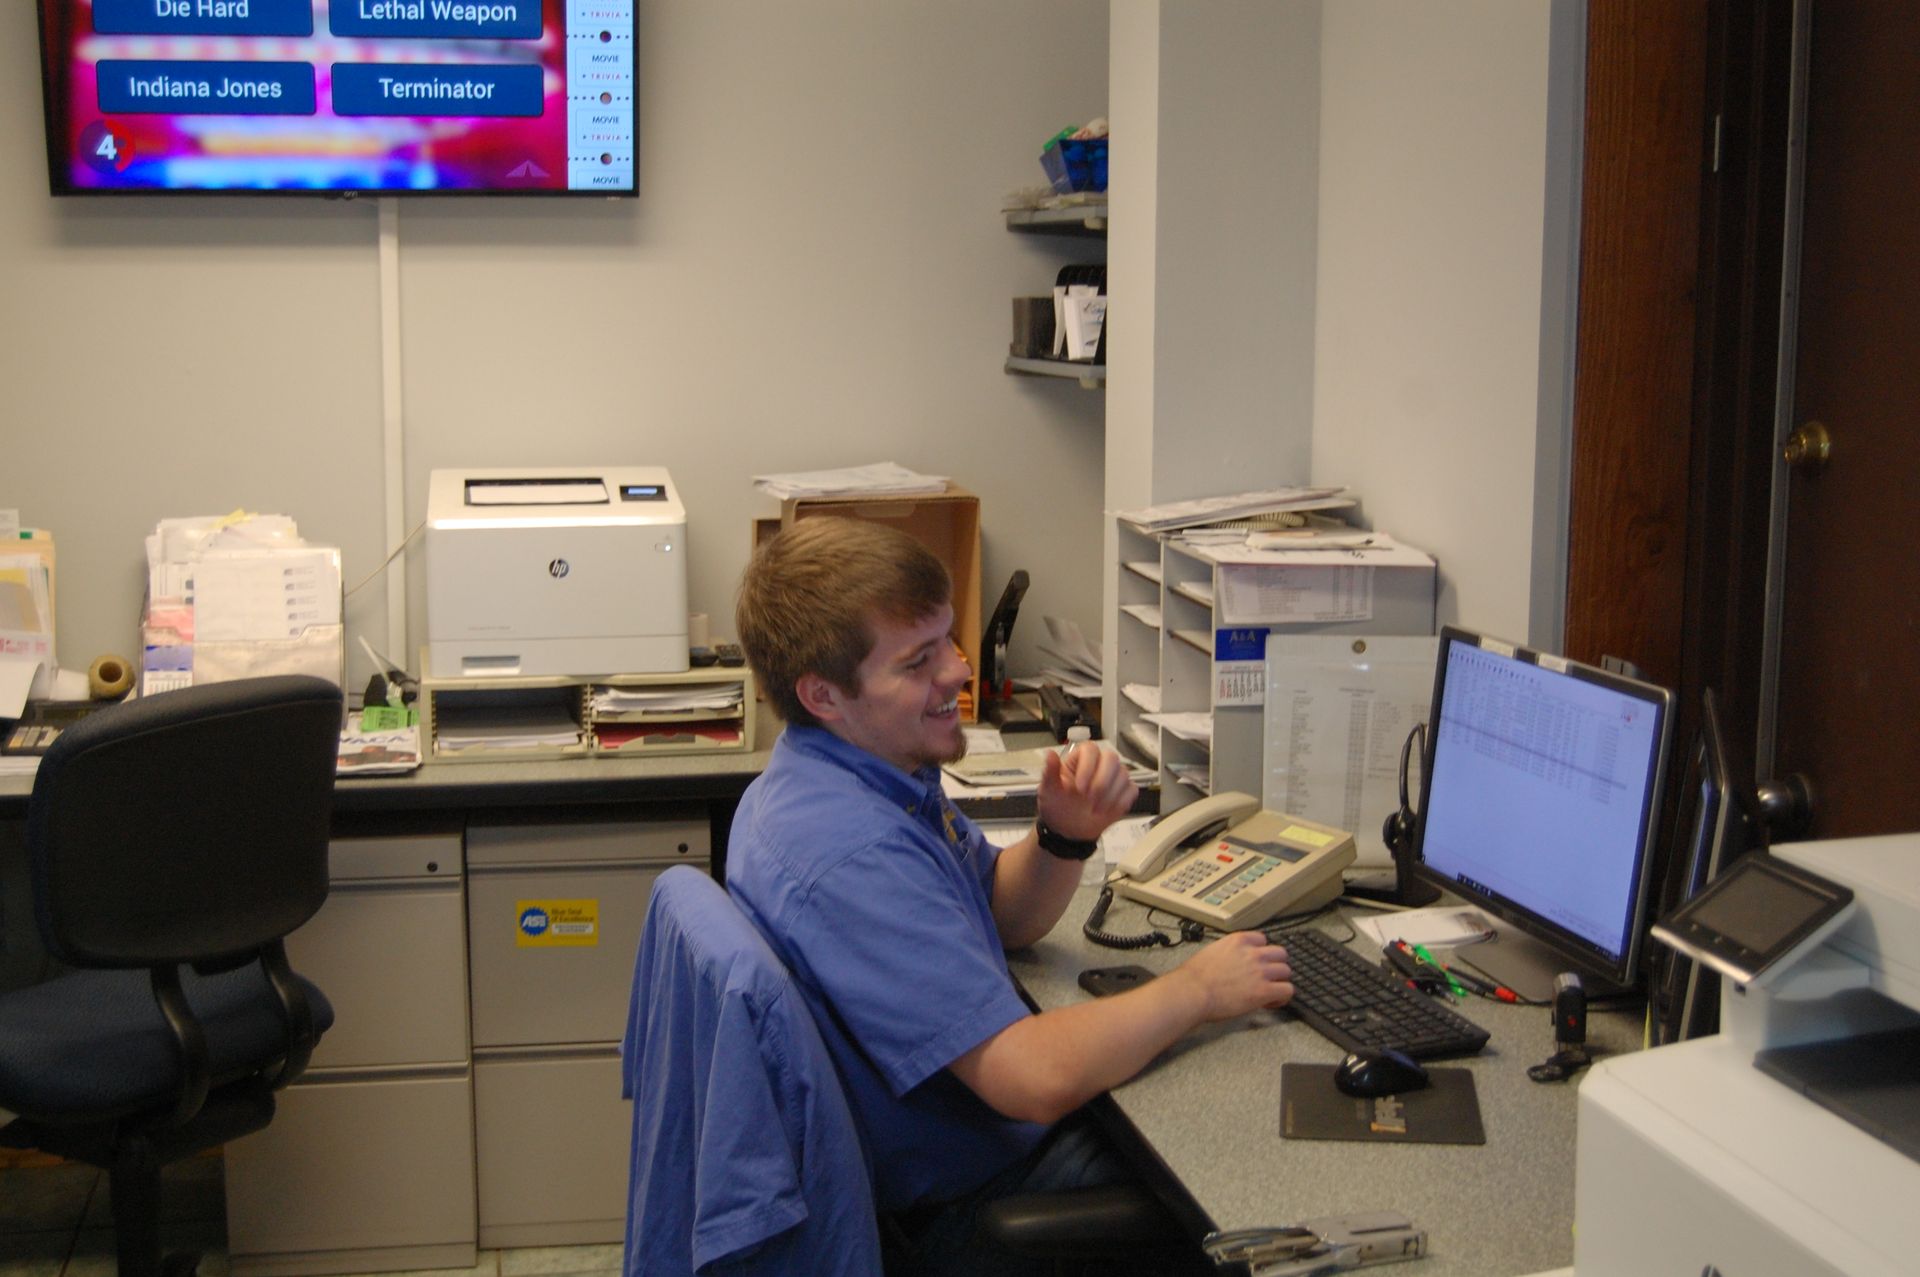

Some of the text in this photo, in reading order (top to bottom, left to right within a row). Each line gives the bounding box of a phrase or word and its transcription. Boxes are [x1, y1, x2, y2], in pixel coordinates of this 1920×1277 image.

[156, 0, 249, 18] Die Hard
[359, 0, 517, 25] Lethal Weapon
[592, 54, 619, 63] MOVIE
[130, 76, 282, 98] Indiana Jones
[379, 78, 495, 99] Terminator
[592, 116, 619, 124] MOVIE
[96, 134, 117, 160] 4
[592, 176, 619, 184] MOVIE
[550, 558, 569, 579] hp
